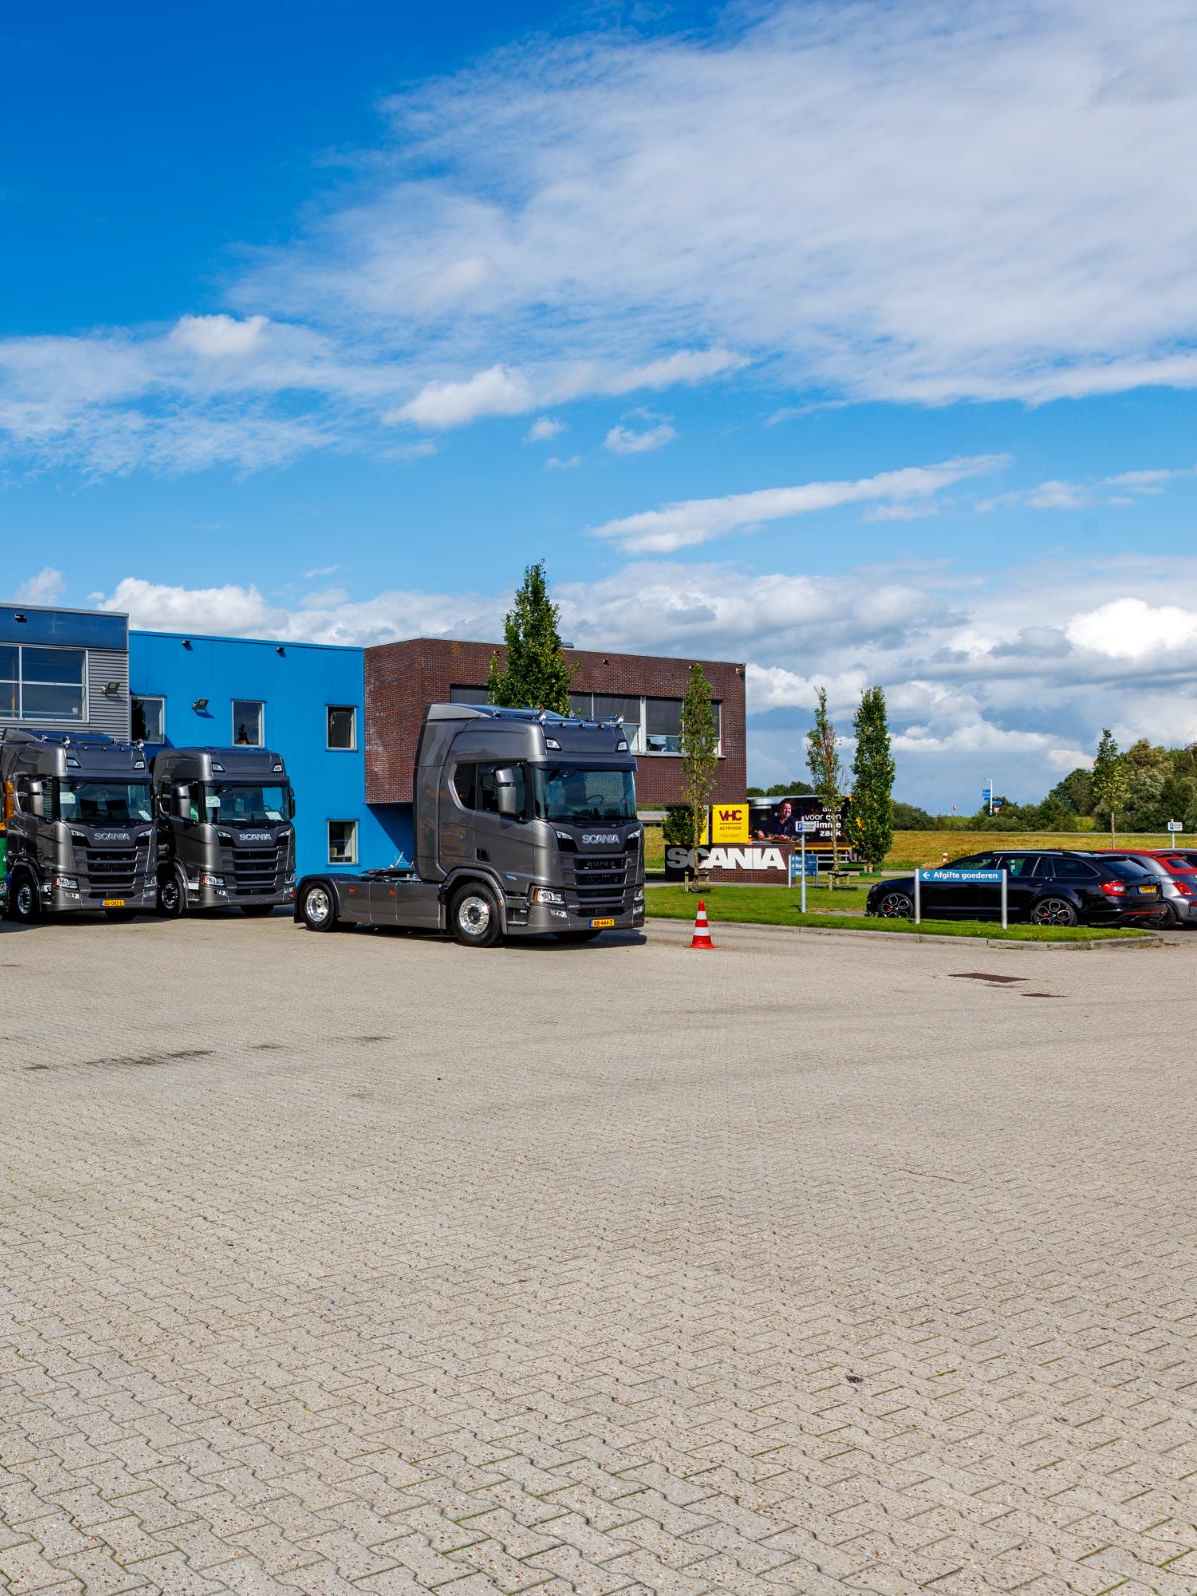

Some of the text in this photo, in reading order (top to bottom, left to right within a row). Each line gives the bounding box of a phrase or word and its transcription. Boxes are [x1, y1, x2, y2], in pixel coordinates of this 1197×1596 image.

[718, 809, 743, 822] VHC
[94, 832, 131, 841] SCANIA
[238, 833, 272, 841] SCANIA
[582, 834, 620, 844] SCANIA
[666, 847, 787, 870] SCANIA
[933, 871, 998, 880] Afgifte goederen
